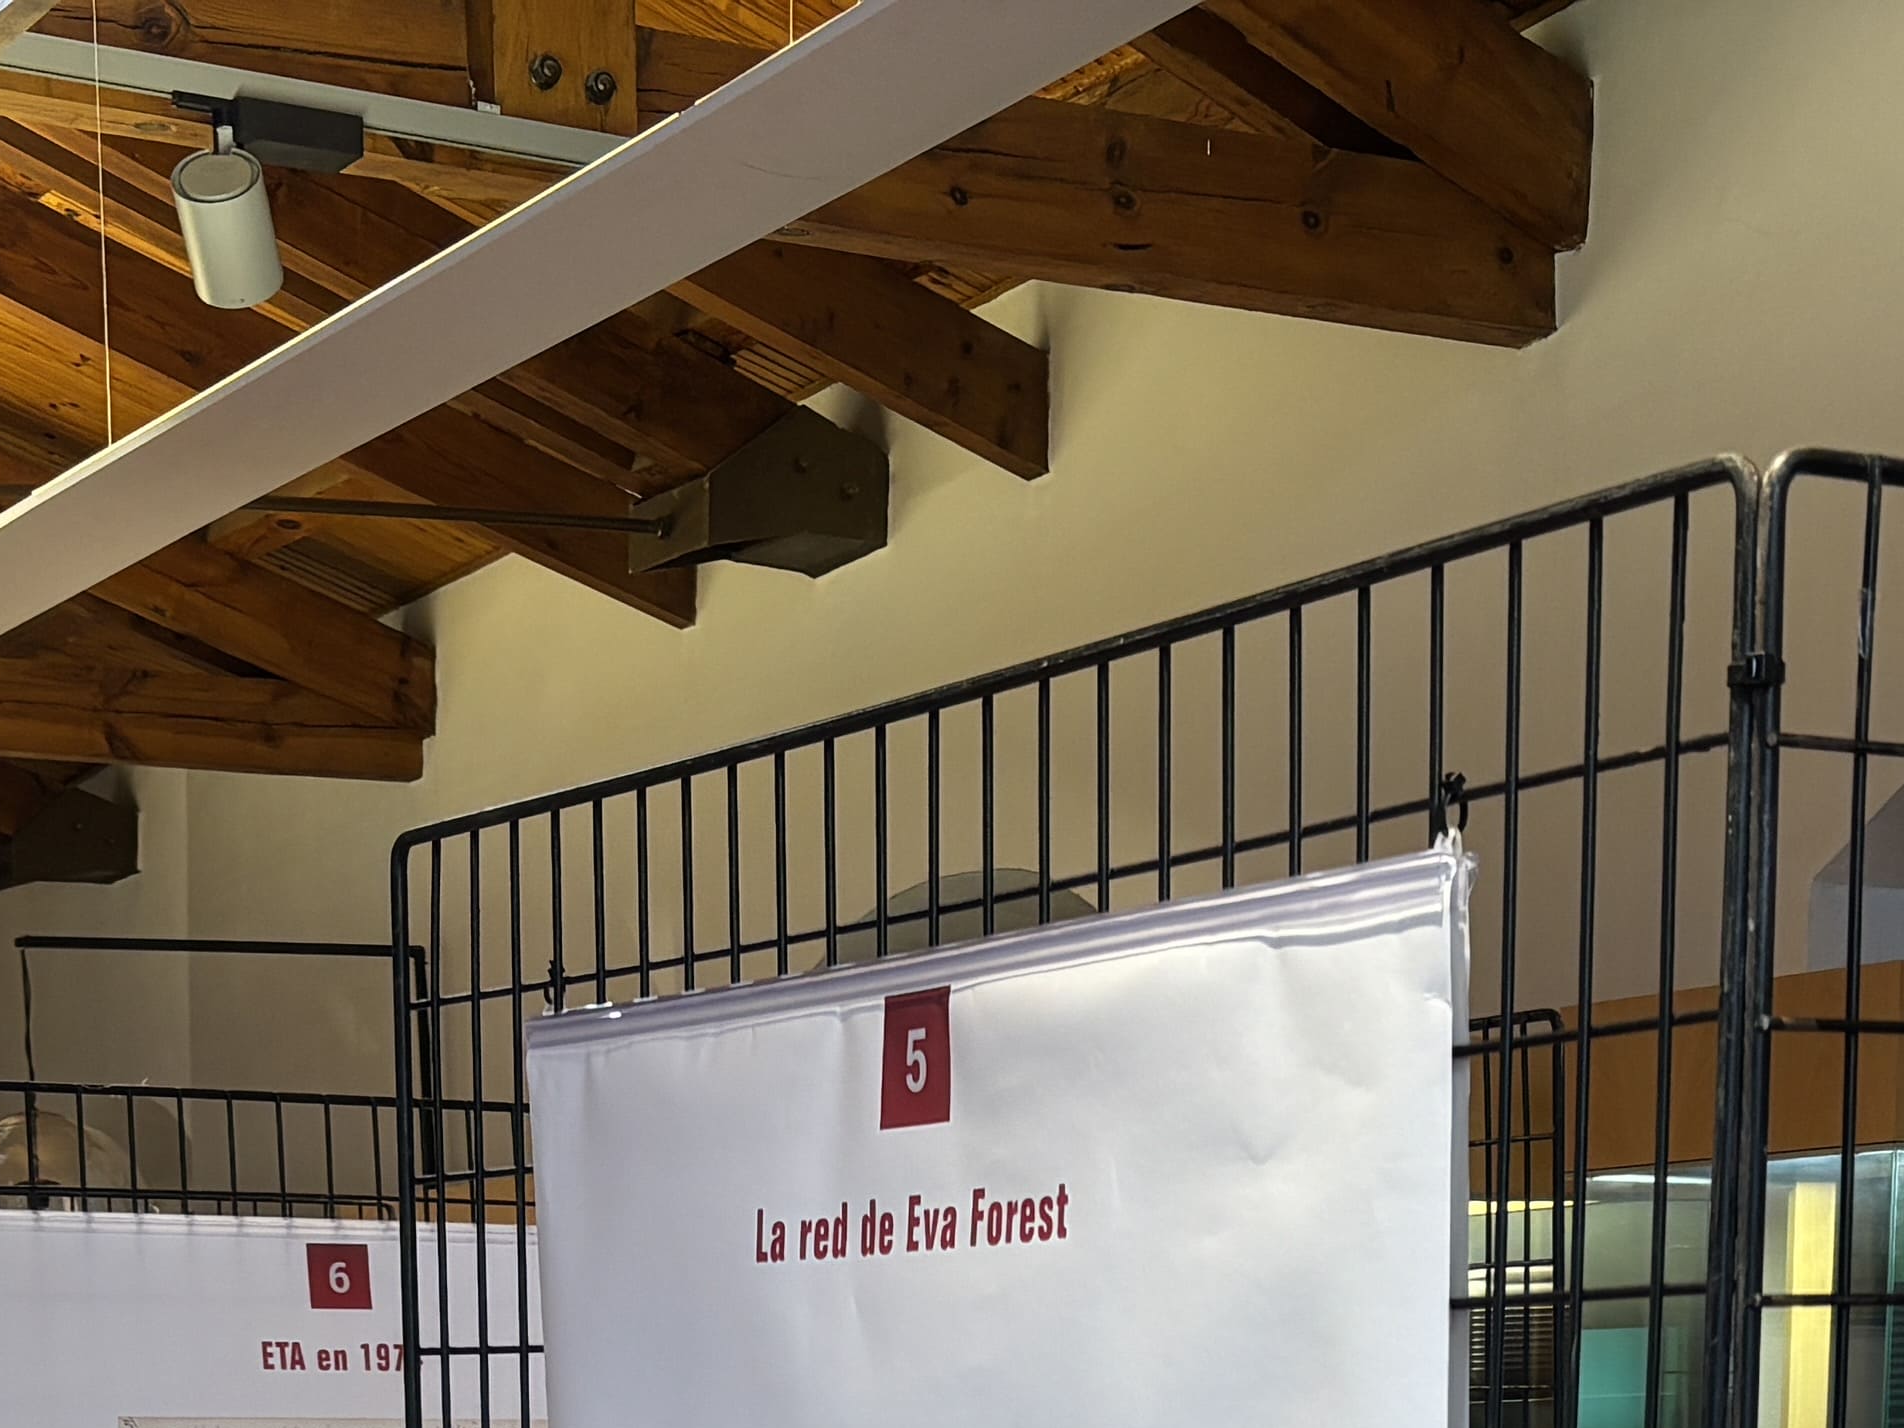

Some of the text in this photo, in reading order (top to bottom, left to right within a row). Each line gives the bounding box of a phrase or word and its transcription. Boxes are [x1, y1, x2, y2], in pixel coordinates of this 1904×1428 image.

[903, 1027, 929, 1096] 5
[756, 1183, 1068, 1263] La red de Eva Forest
[328, 1261, 351, 1294] 6
[261, 1341, 423, 1372] ETA en 197
